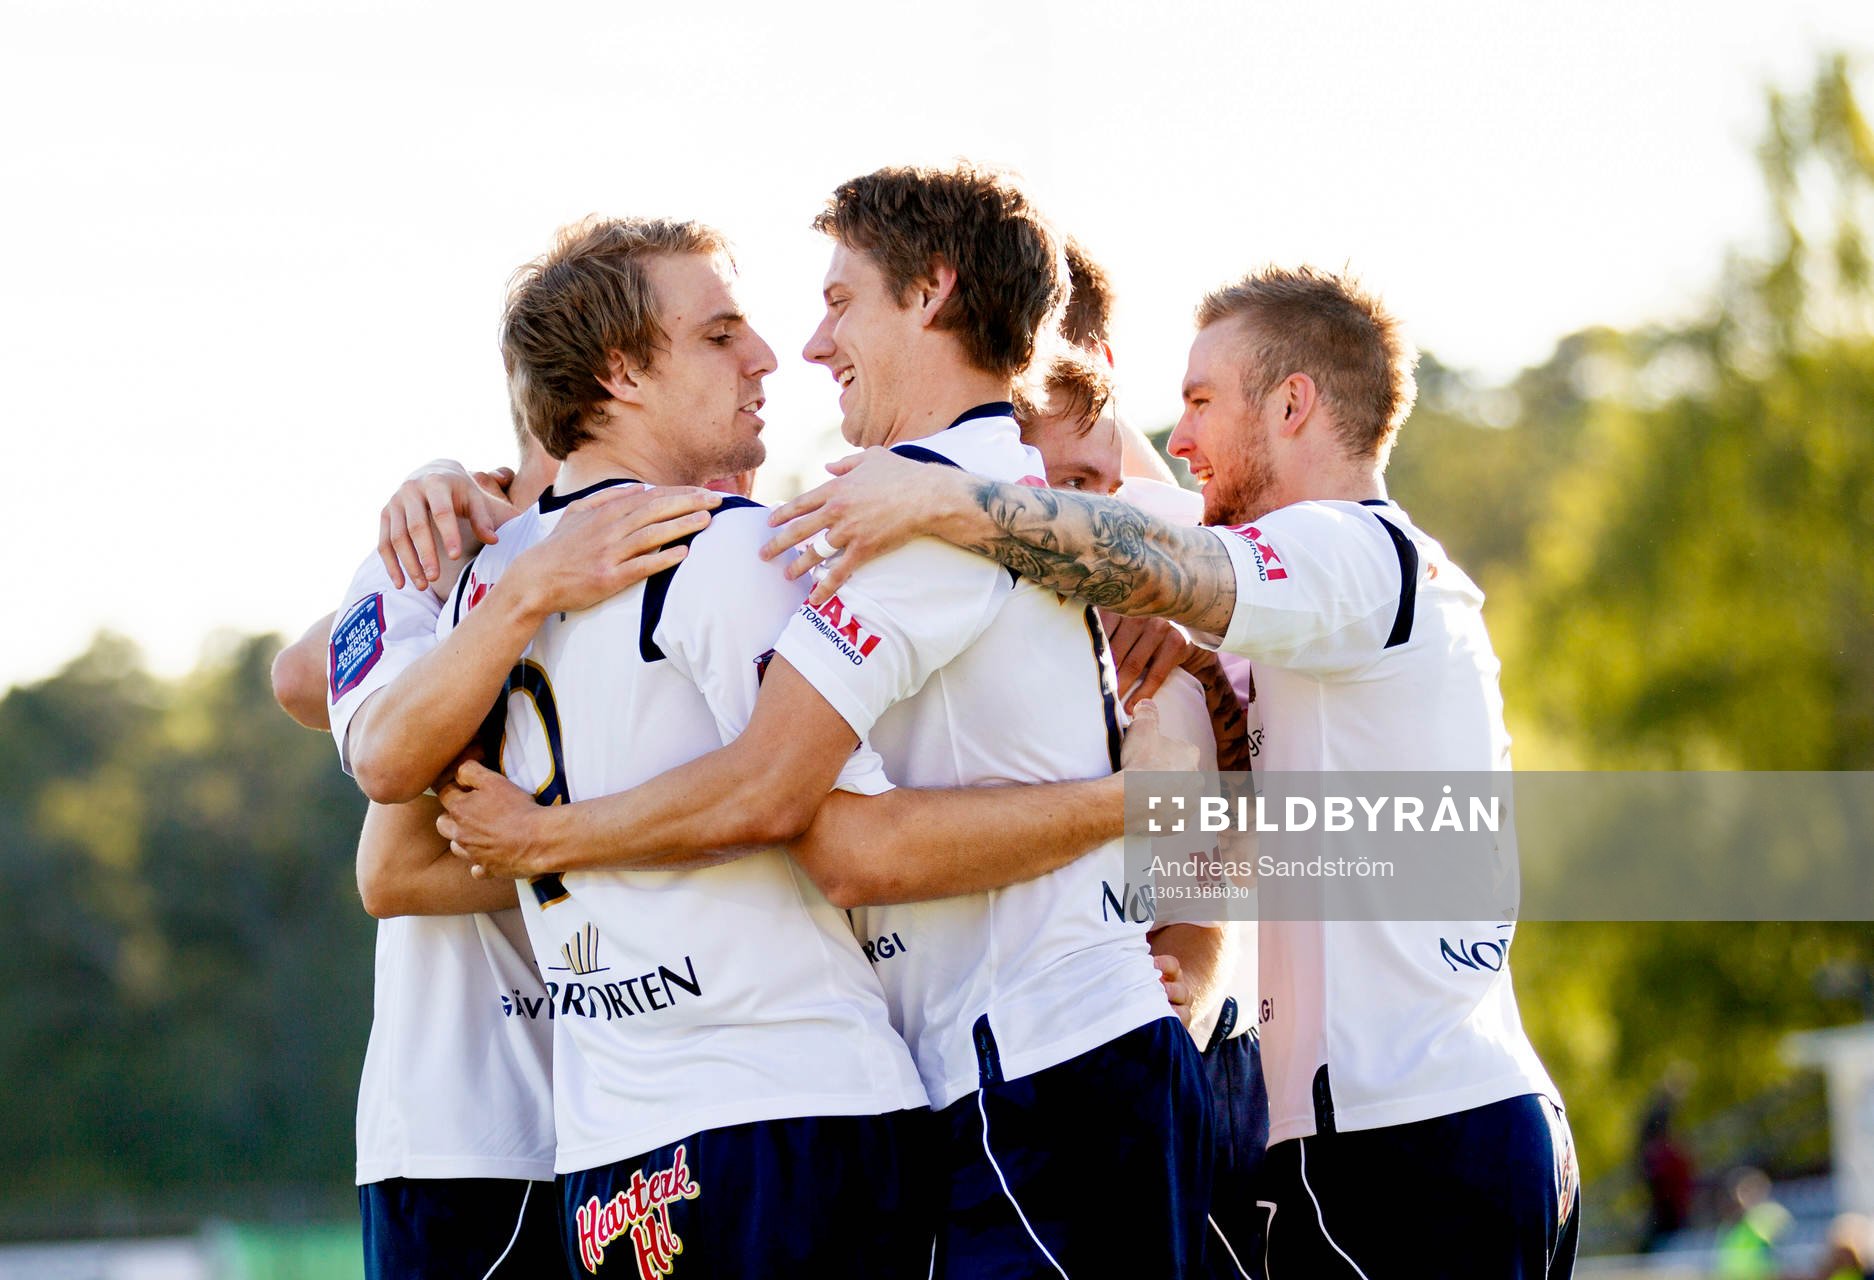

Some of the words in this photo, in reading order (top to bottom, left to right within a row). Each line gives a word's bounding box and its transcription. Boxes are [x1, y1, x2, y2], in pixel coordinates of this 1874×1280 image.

[1223, 524, 1288, 580] AXI
[800, 606, 863, 666] TORMARKNAD
[803, 581, 882, 658] AXI
